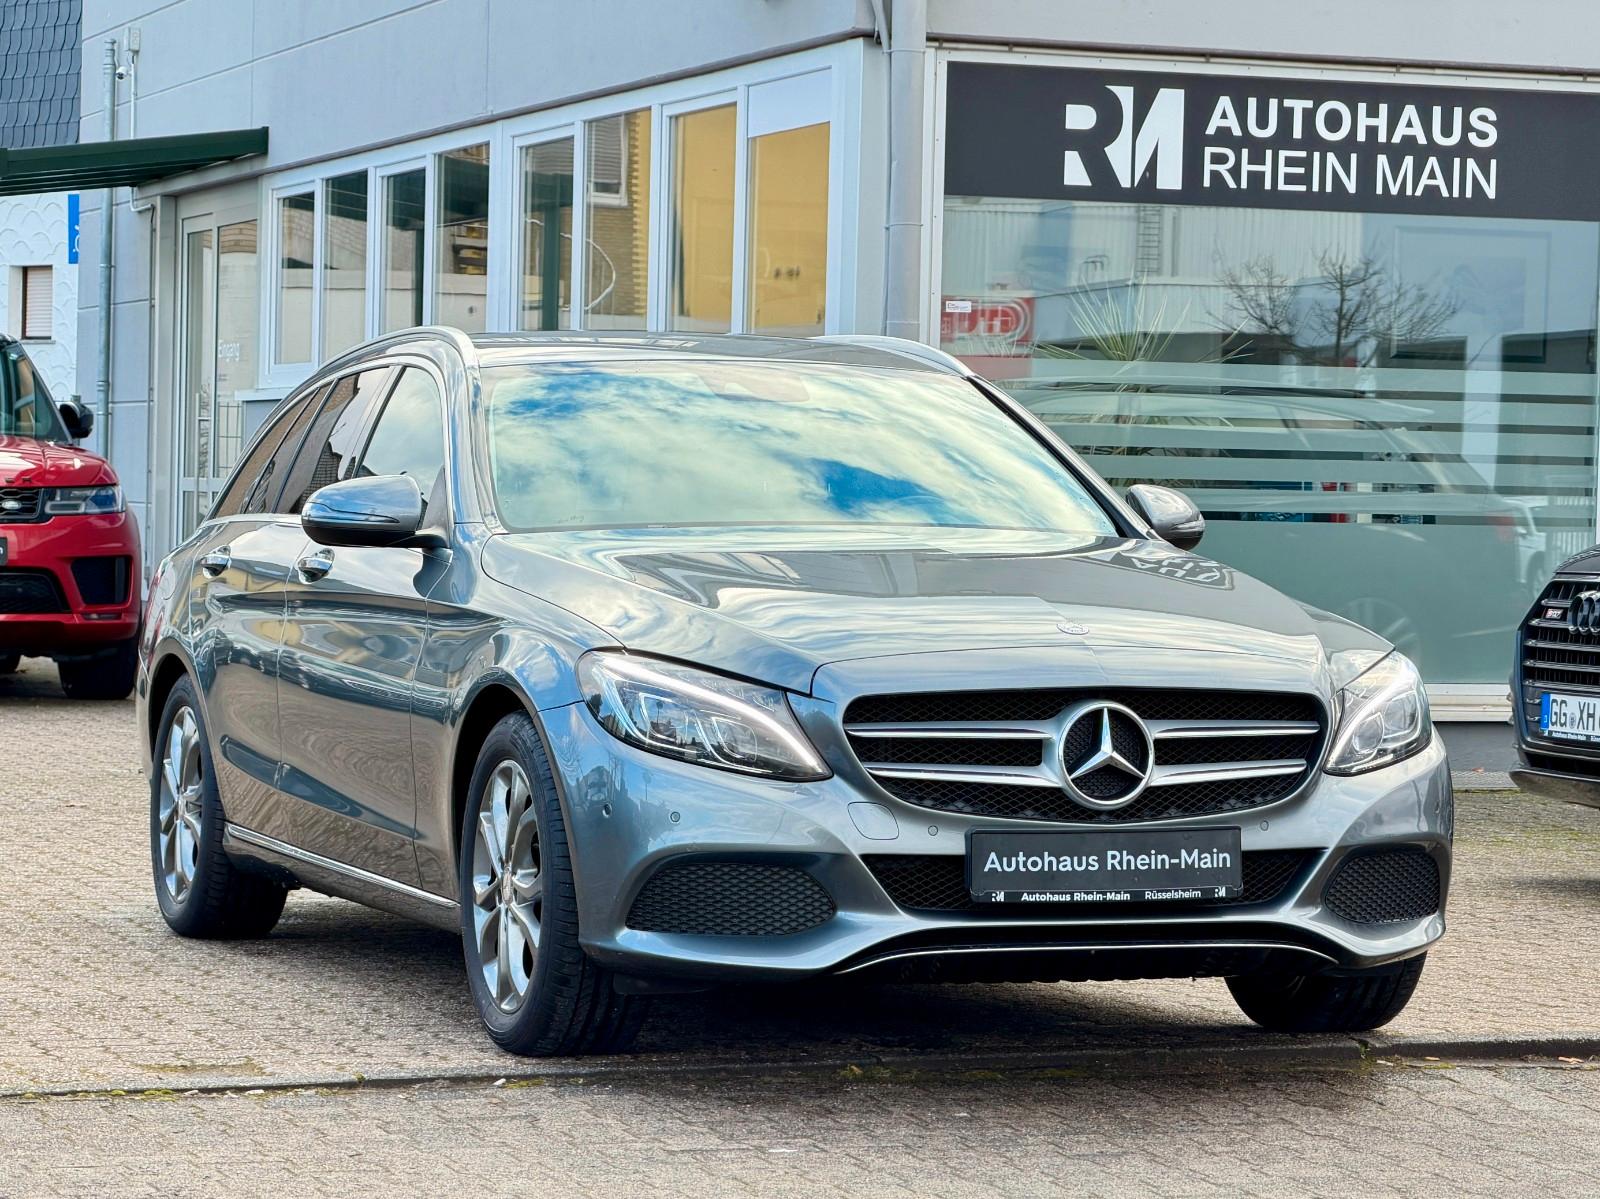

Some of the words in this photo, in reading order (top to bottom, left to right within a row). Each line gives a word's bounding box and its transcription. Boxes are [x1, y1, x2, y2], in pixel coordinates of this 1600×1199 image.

[1204, 95, 1498, 148] AUTOHAUS
[1202, 146, 1358, 194] RHEIN
[1376, 153, 1497, 200] MAIN
[1550, 698, 1568, 728] GG
[983, 851, 1100, 872] Autohaus
[1106, 848, 1231, 871] Rhein-Main
[1021, 892, 1071, 902] Autohaus
[1073, 890, 1131, 902] Rhein-Main
[1144, 889, 1202, 900] Rüsselsheim
